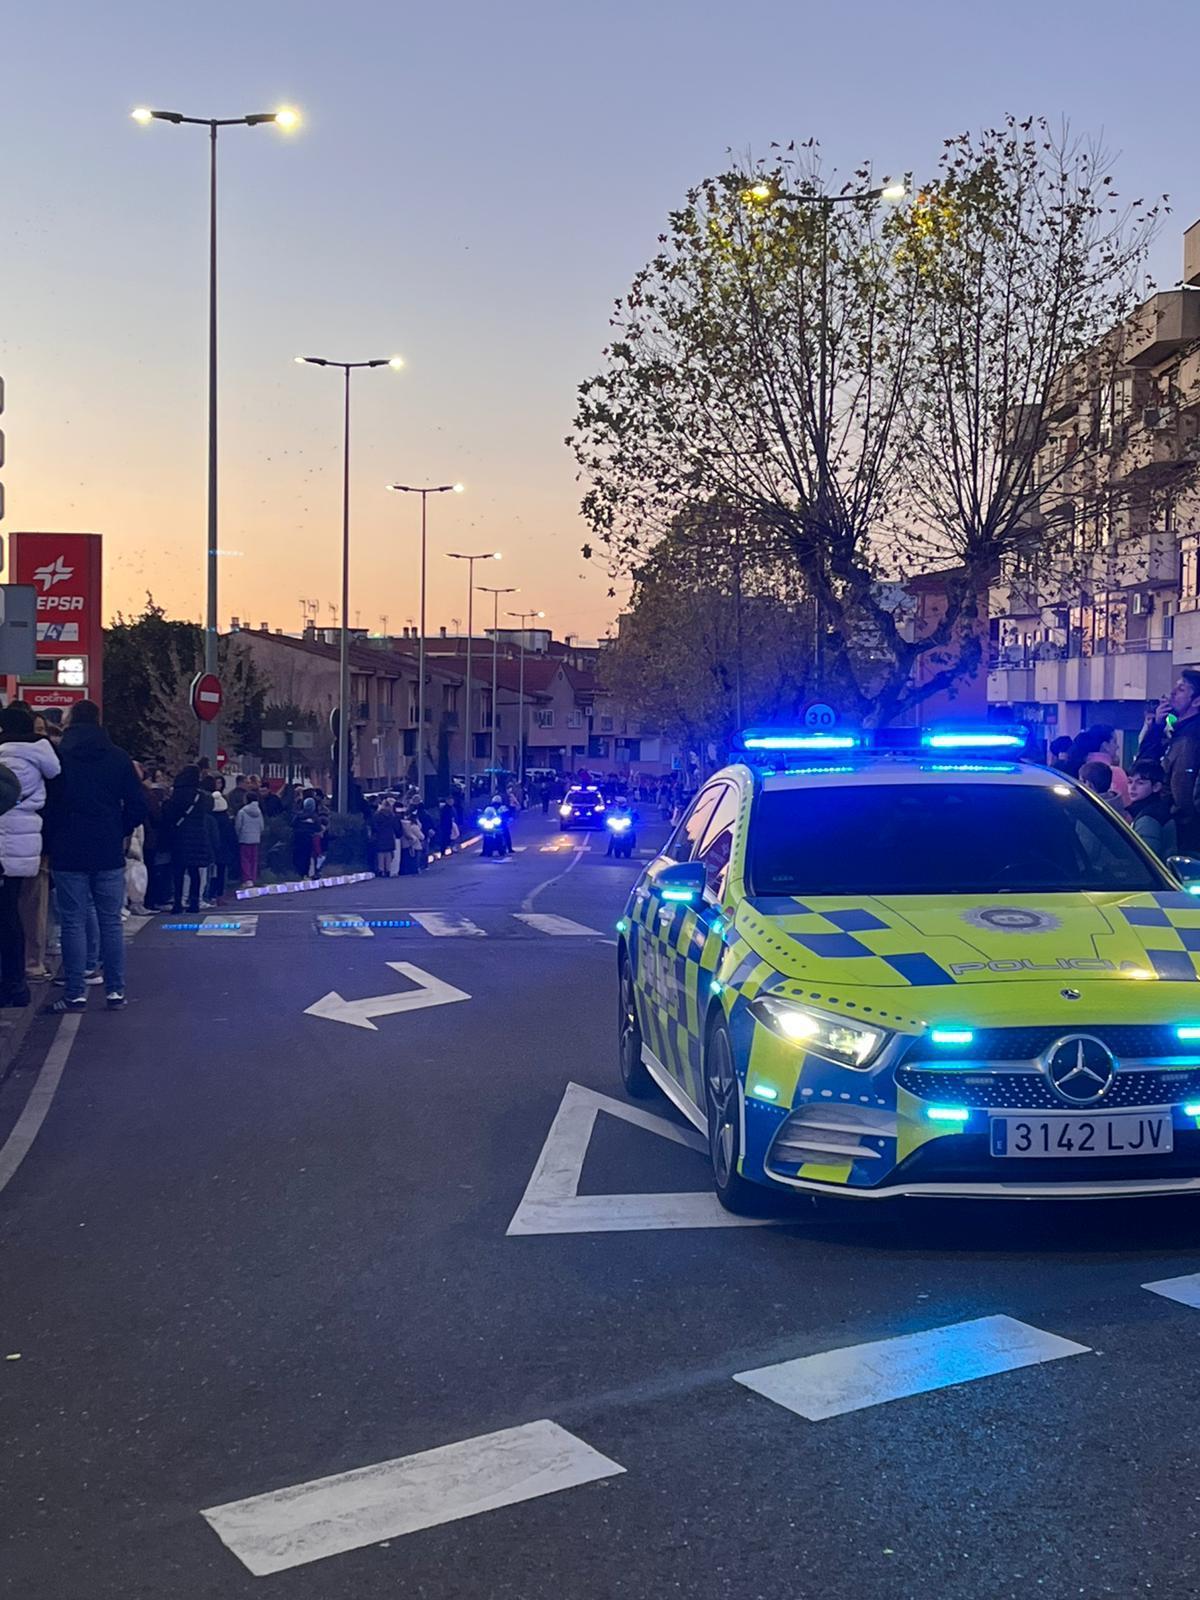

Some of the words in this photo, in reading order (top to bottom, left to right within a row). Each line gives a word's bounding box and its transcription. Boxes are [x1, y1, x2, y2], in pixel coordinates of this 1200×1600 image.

[36, 596, 84, 610] EPSA
[34, 692, 73, 703] optima
[809, 712, 832, 725] 30
[1015, 1123, 1095, 1151] 3142
[1108, 1119, 1163, 1150] LJV
